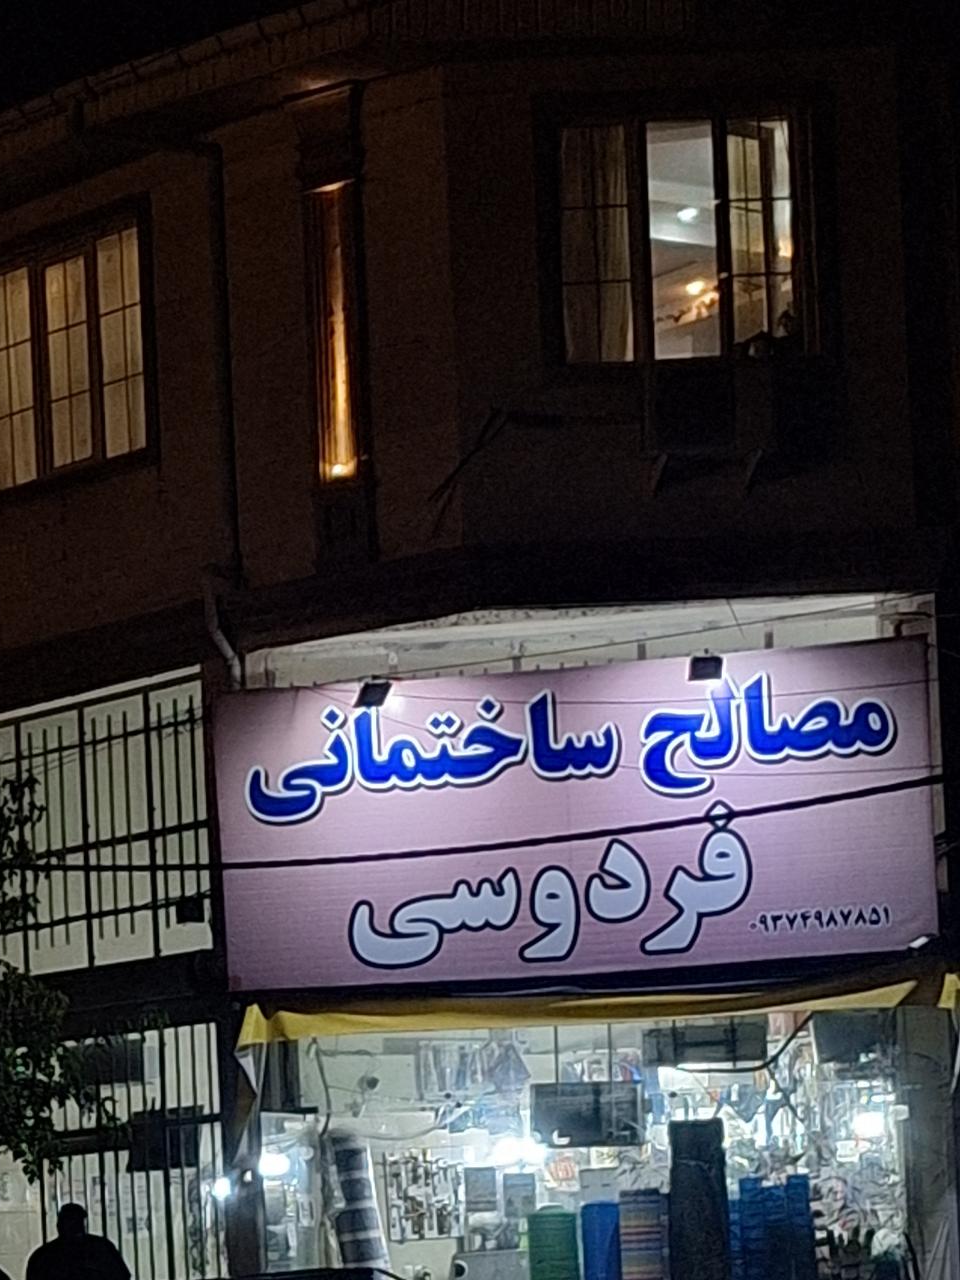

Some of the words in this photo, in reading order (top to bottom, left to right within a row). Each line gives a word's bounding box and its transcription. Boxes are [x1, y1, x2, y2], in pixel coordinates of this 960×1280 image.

[246, 689, 622, 825] ساختمانی
[640, 672, 897, 798] مصالح
[348, 799, 753, 969] فردوسی
